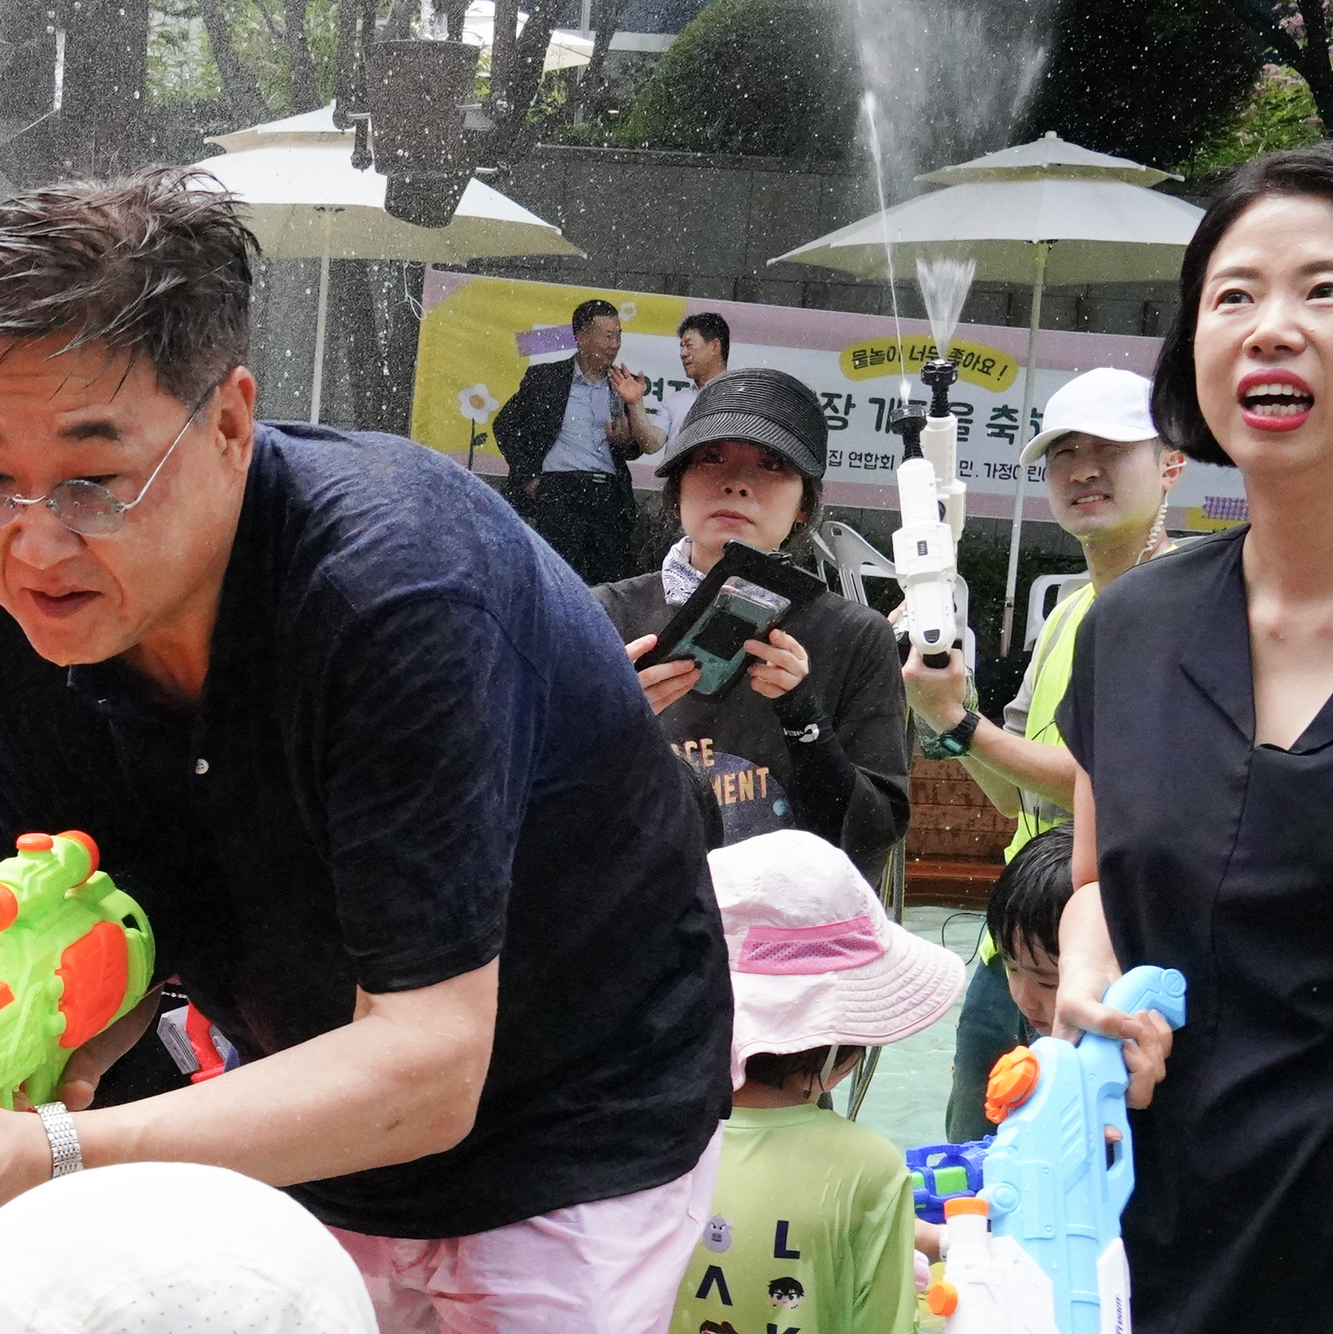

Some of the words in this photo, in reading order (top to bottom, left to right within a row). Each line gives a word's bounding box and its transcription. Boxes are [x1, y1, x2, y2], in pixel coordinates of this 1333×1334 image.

[851, 345, 903, 371] 물놀이
[868, 396, 975, 443] 개을
[847, 451, 895, 471] 연합회
